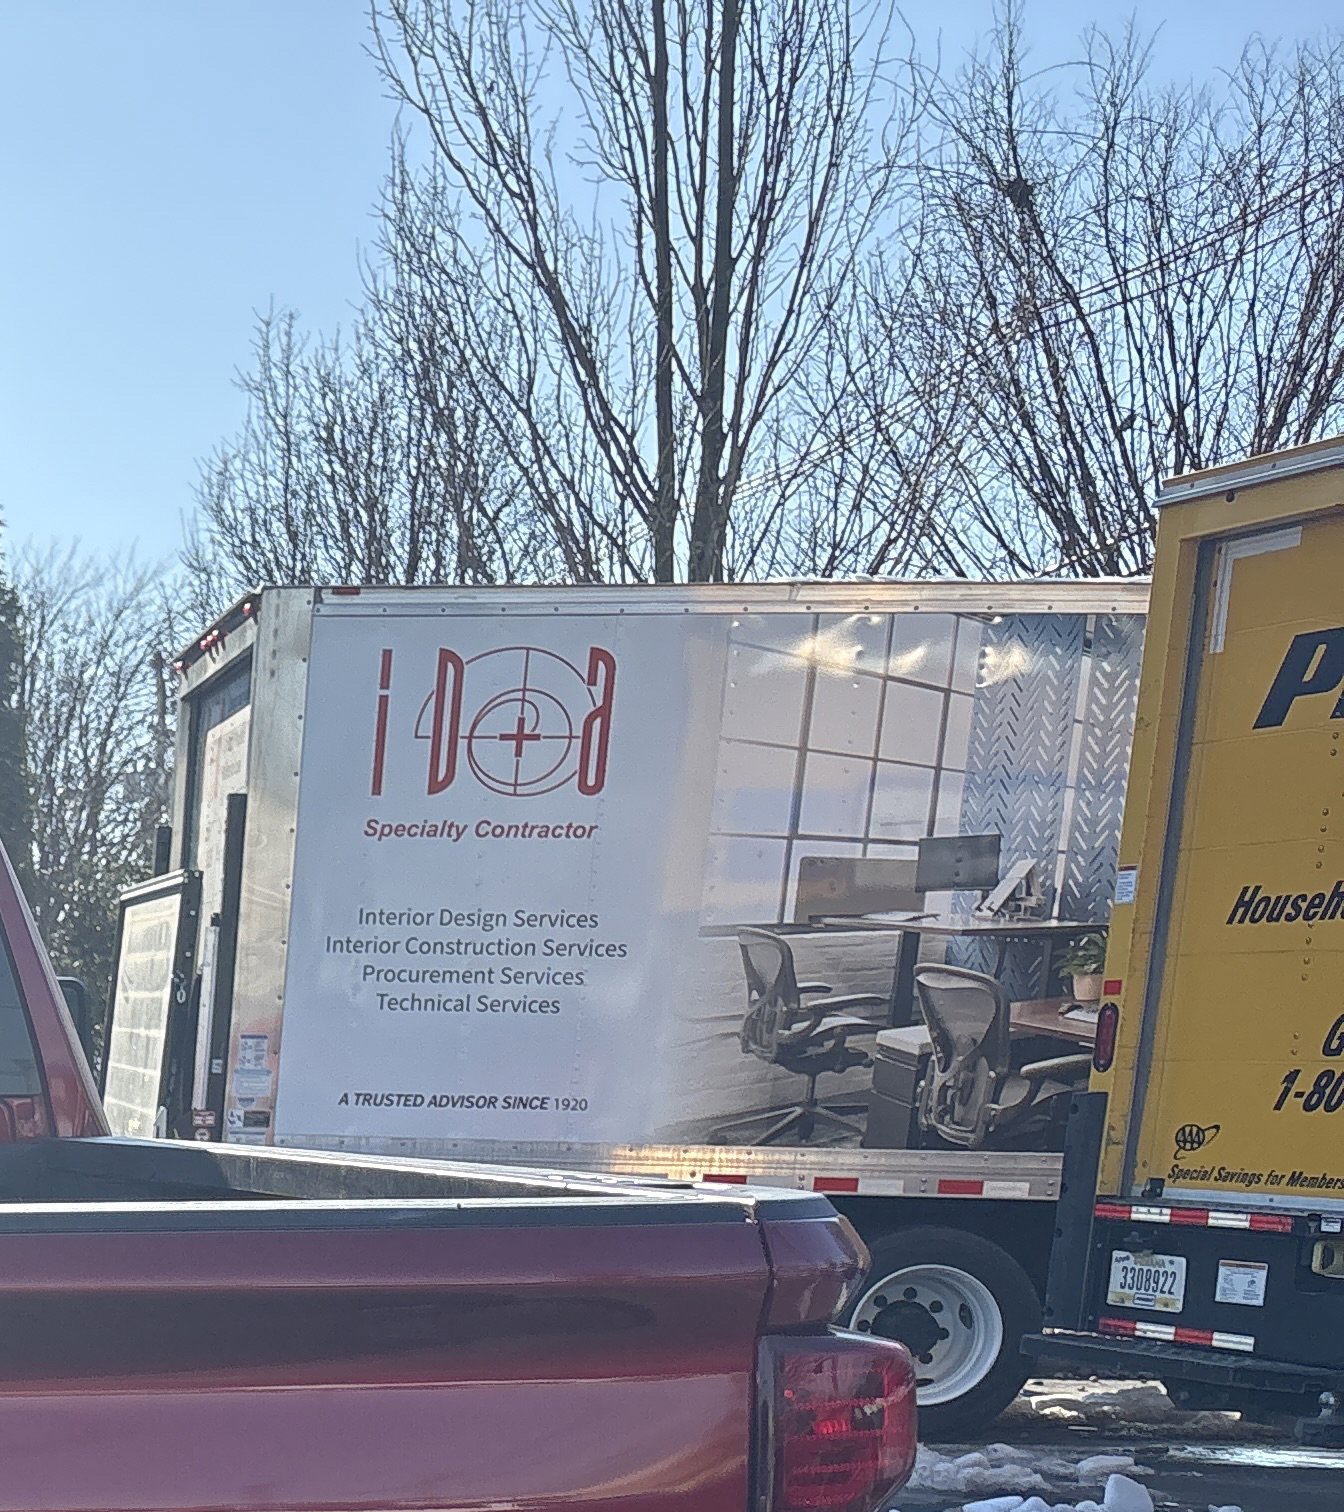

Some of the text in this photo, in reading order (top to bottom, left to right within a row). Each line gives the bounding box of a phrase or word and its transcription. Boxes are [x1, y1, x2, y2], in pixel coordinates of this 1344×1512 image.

[363, 818, 599, 842] Specialty Contractor
[1225, 879, 1344, 925] Househ
[358, 907, 599, 932] Interior Design Services
[325, 936, 628, 958] Interior Construction Services
[362, 964, 585, 987] Procurement Services
[375, 992, 561, 1015] Technical Services
[337, 1092, 588, 1112] A TRUSTED ADVISOR SINCE 1920
[1167, 1163, 1214, 1184] Special
[1213, 1166, 1264, 1188] Savings
[1263, 1170, 1286, 1187] for
[1119, 1265, 1178, 1296] 3308922
